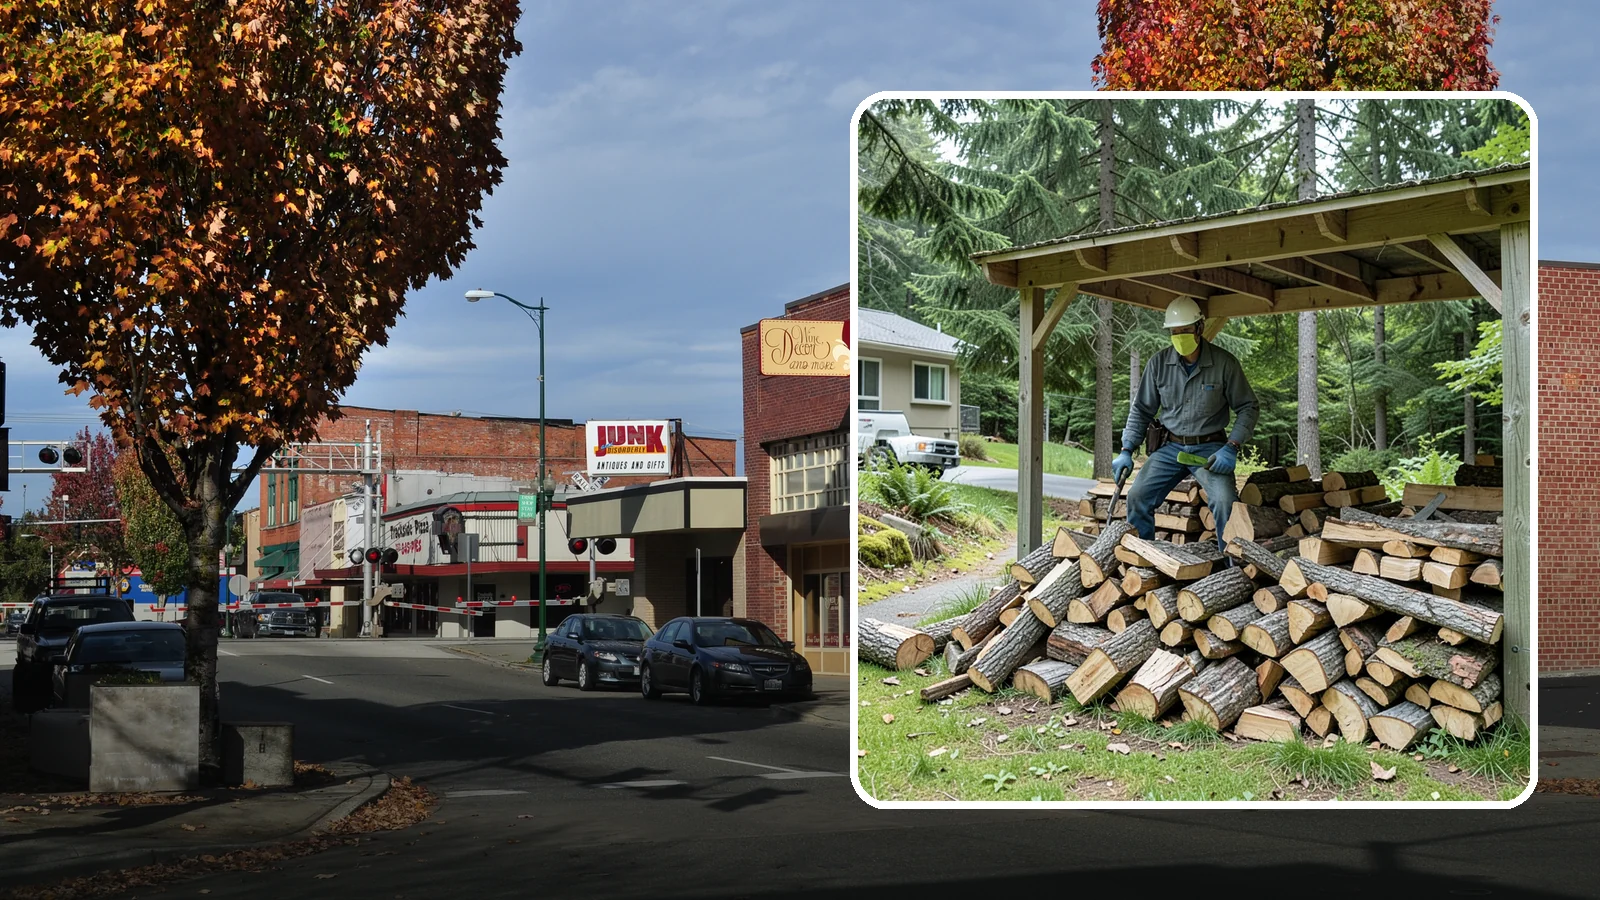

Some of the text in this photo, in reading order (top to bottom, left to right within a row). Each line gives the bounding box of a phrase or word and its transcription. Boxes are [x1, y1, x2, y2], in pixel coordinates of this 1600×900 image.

[595, 425, 665, 457] JUNK
[607, 446, 646, 454] DISORDERLY
[597, 461, 665, 470] ANTIQUES AND GIFTS
[414, 519, 429, 535] Pizza
